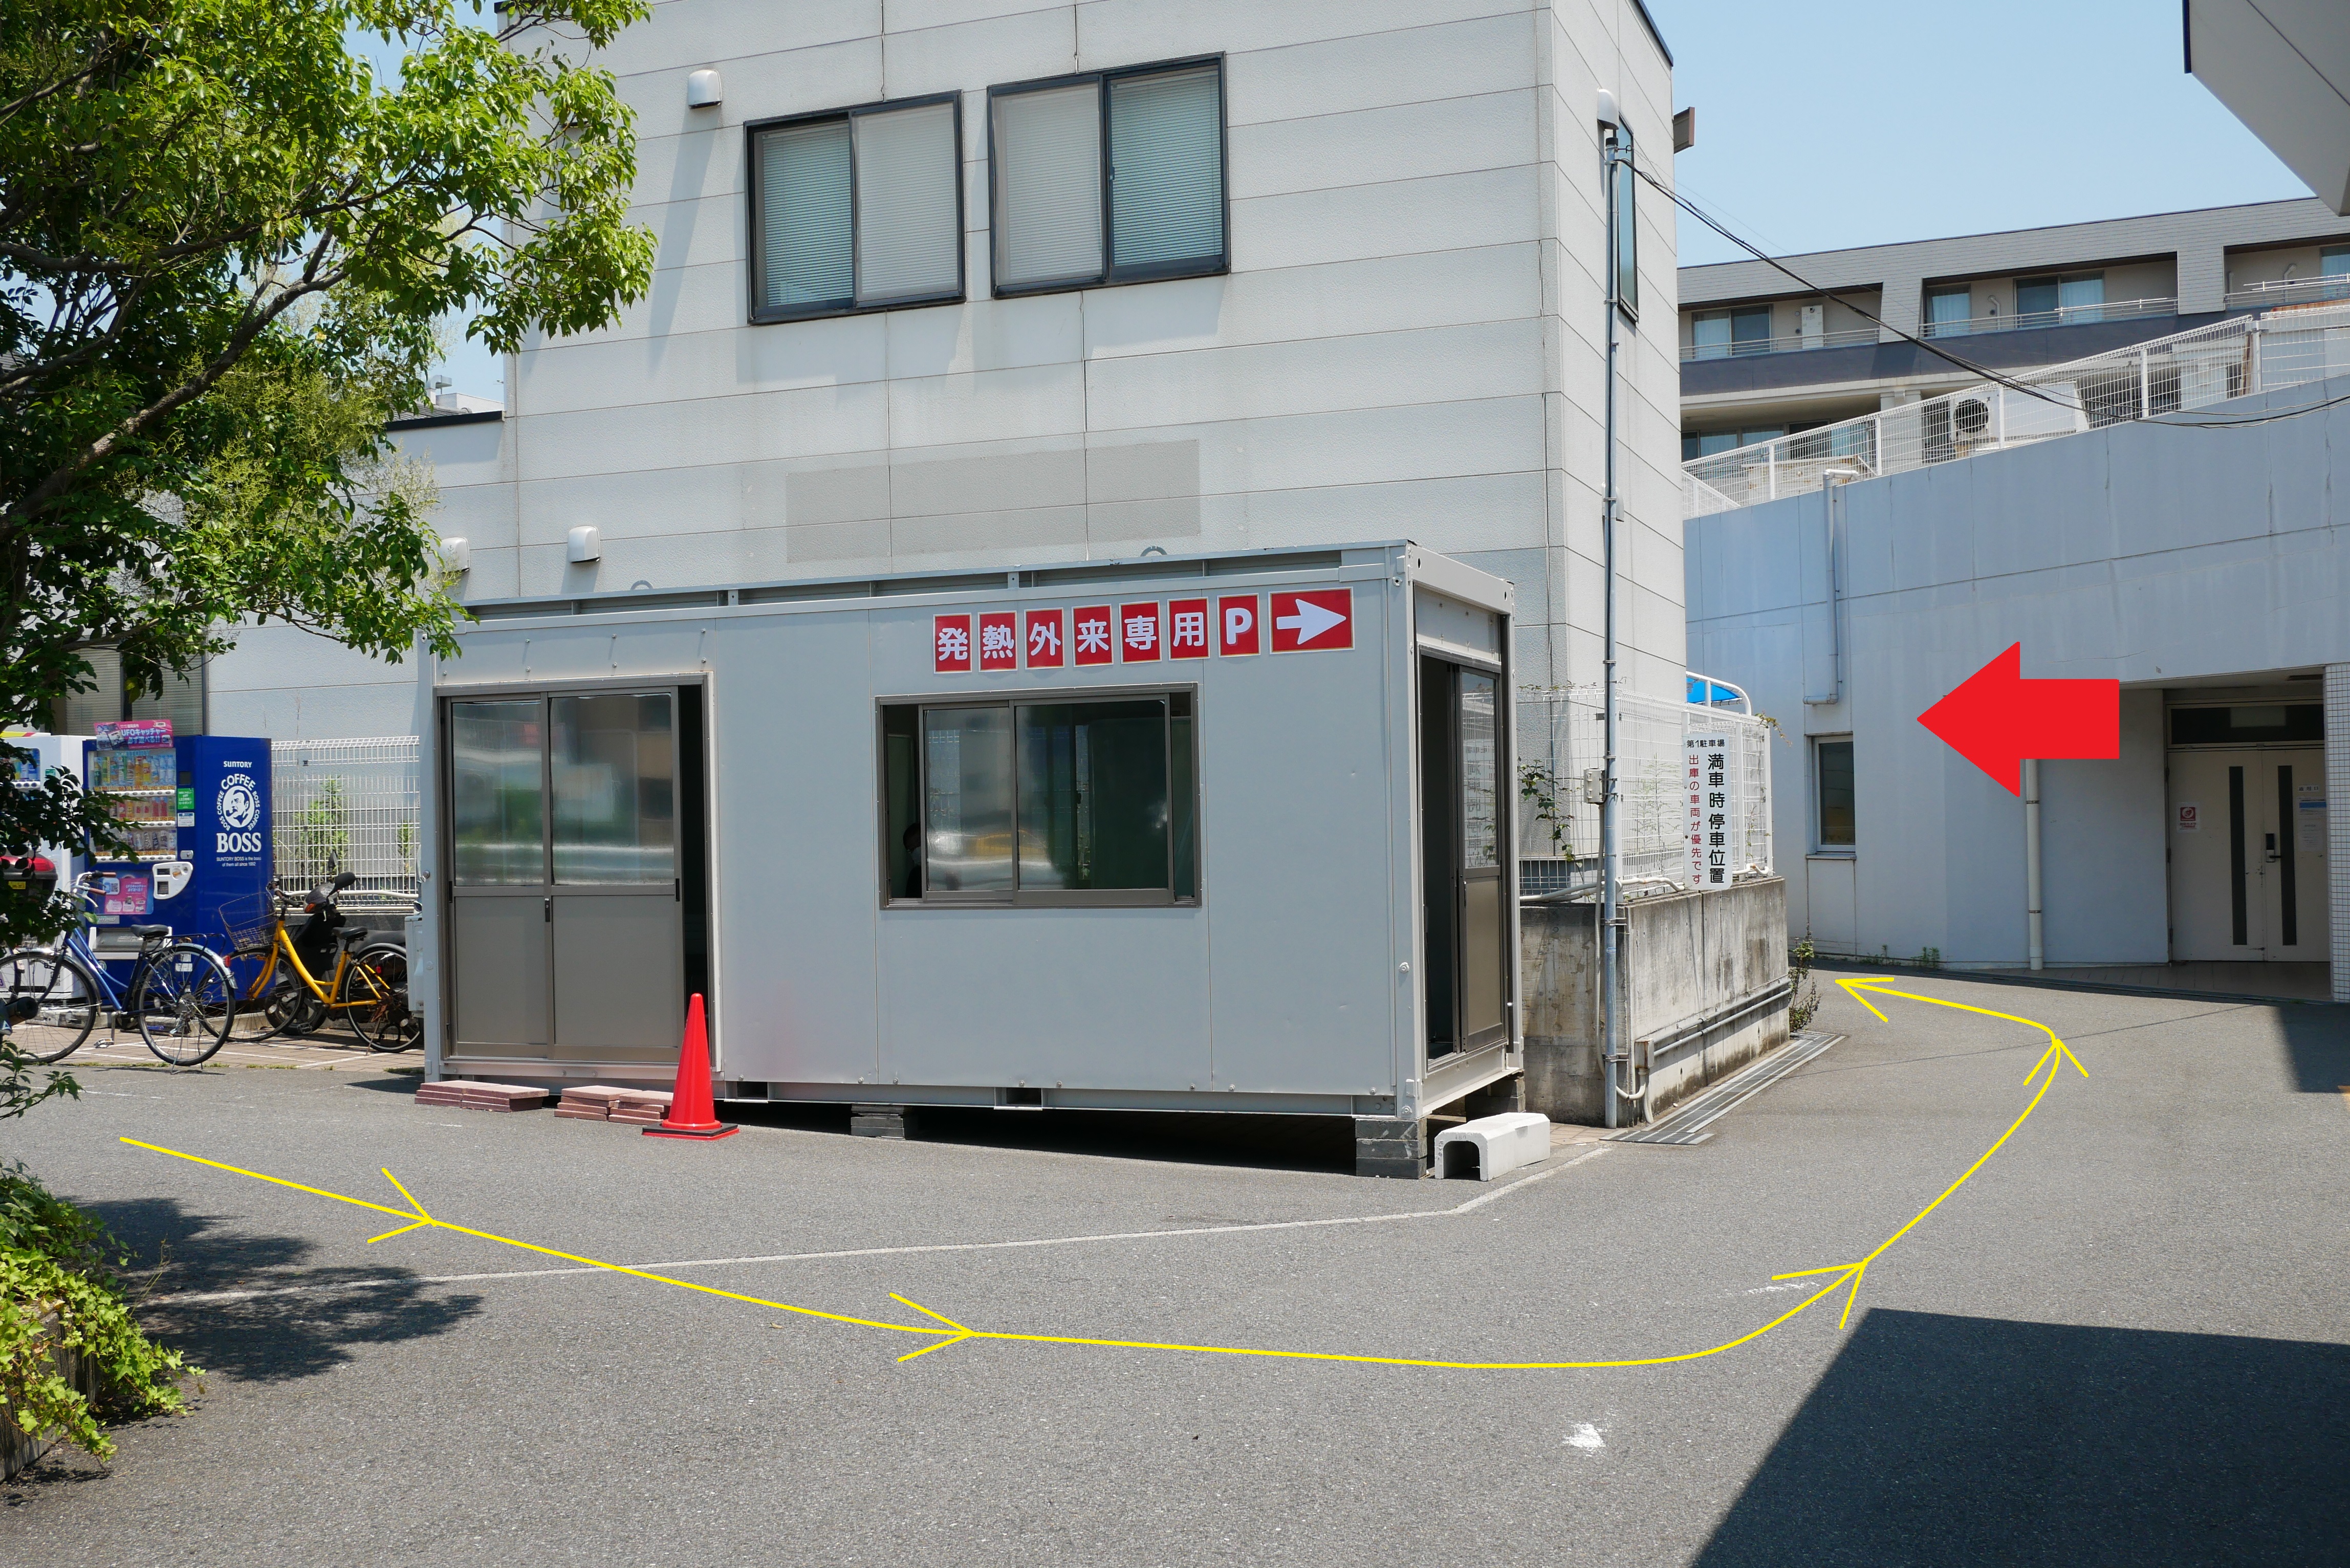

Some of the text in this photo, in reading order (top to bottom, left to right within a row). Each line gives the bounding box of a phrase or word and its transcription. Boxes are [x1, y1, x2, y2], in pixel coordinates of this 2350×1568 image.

[938, 607, 1253, 661] 発熱外来専用P
[121, 728, 166, 736] UFOキャッチャー
[1686, 739, 1725, 748] 第1駐車場
[221, 773, 256, 791] COFFEE
[248, 791, 260, 831] BOSS COFFEE
[1689, 754, 1702, 885] 出庫の車両が優先です
[1708, 753, 1726, 884] 満車時停車位置
[219, 816, 231, 831] BOSS
[216, 832, 262, 853] BOSS
